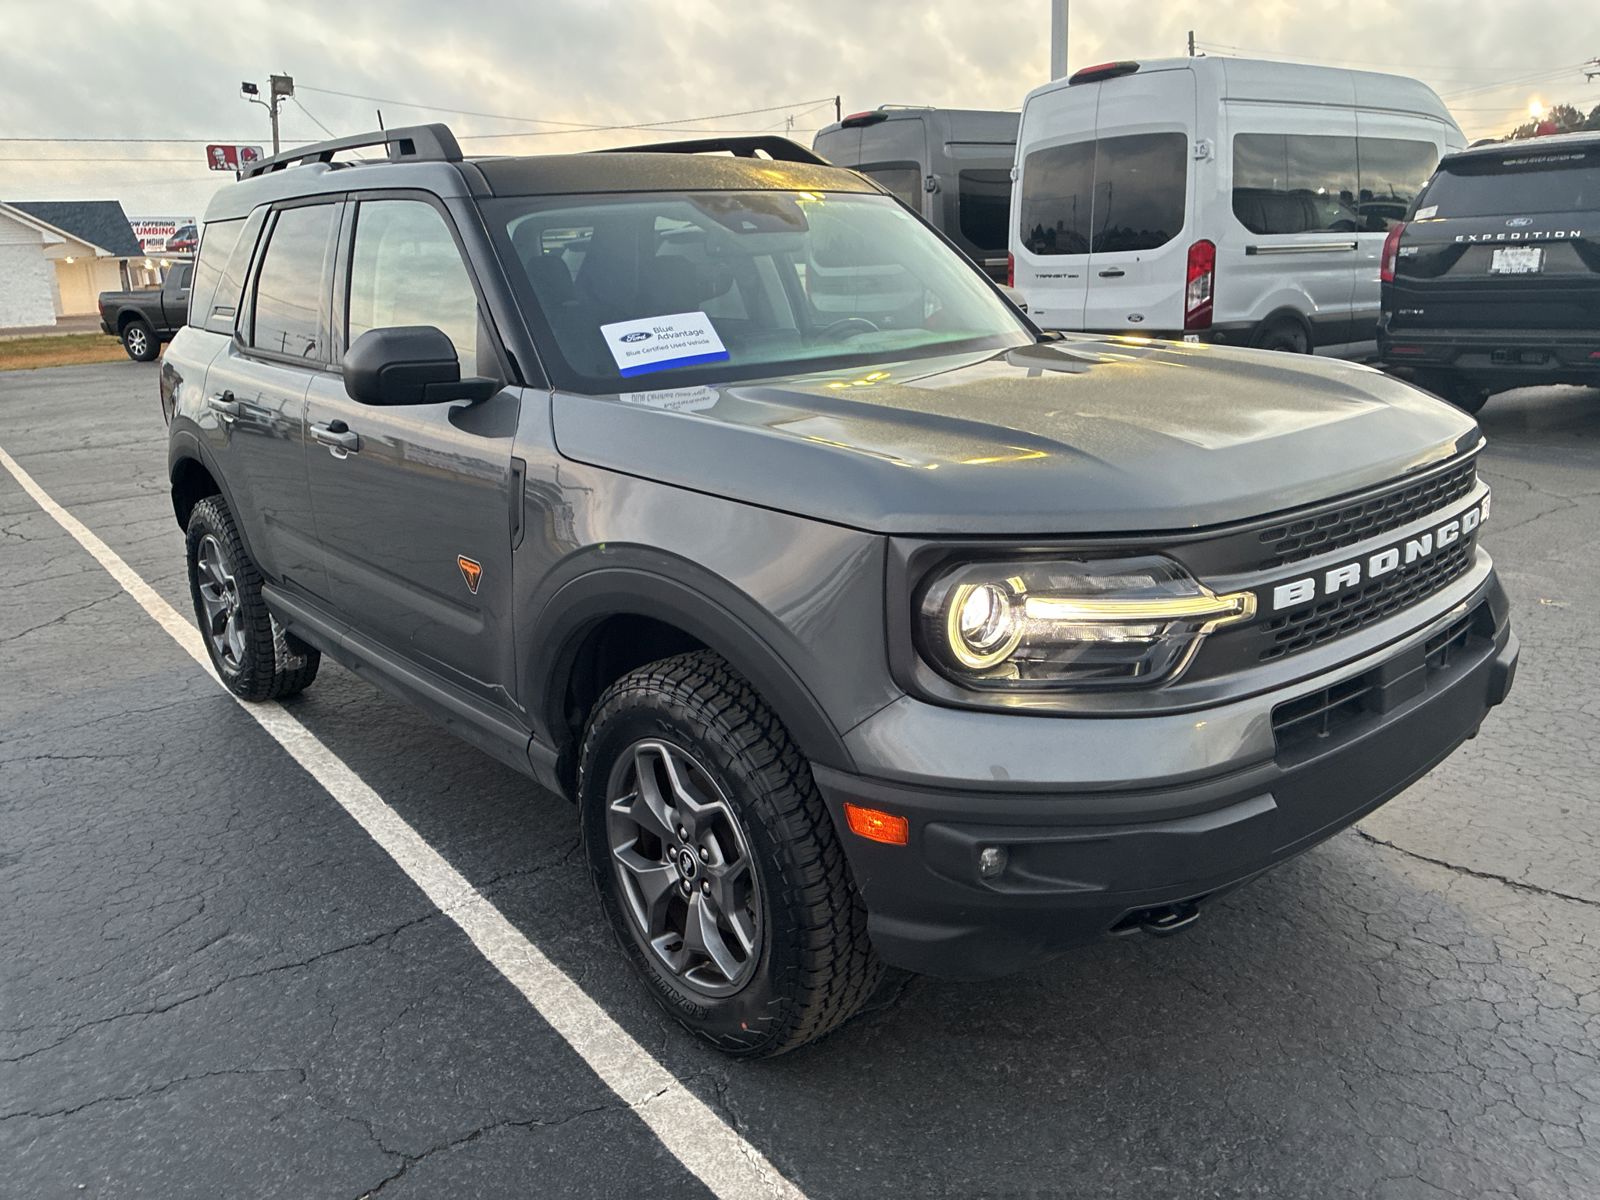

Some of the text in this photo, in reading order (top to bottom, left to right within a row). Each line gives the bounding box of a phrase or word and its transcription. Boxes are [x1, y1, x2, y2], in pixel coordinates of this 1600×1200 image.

[136, 227, 175, 235] UMBING
[1455, 230, 1581, 242] EXPEDITION
[146, 238, 164, 247] MOHR
[653, 326, 674, 334] Blue
[658, 329, 704, 340] Advantage
[625, 332, 648, 342] Ford
[642, 345, 669, 353] Certified
[1273, 507, 1481, 611] BRONCO
